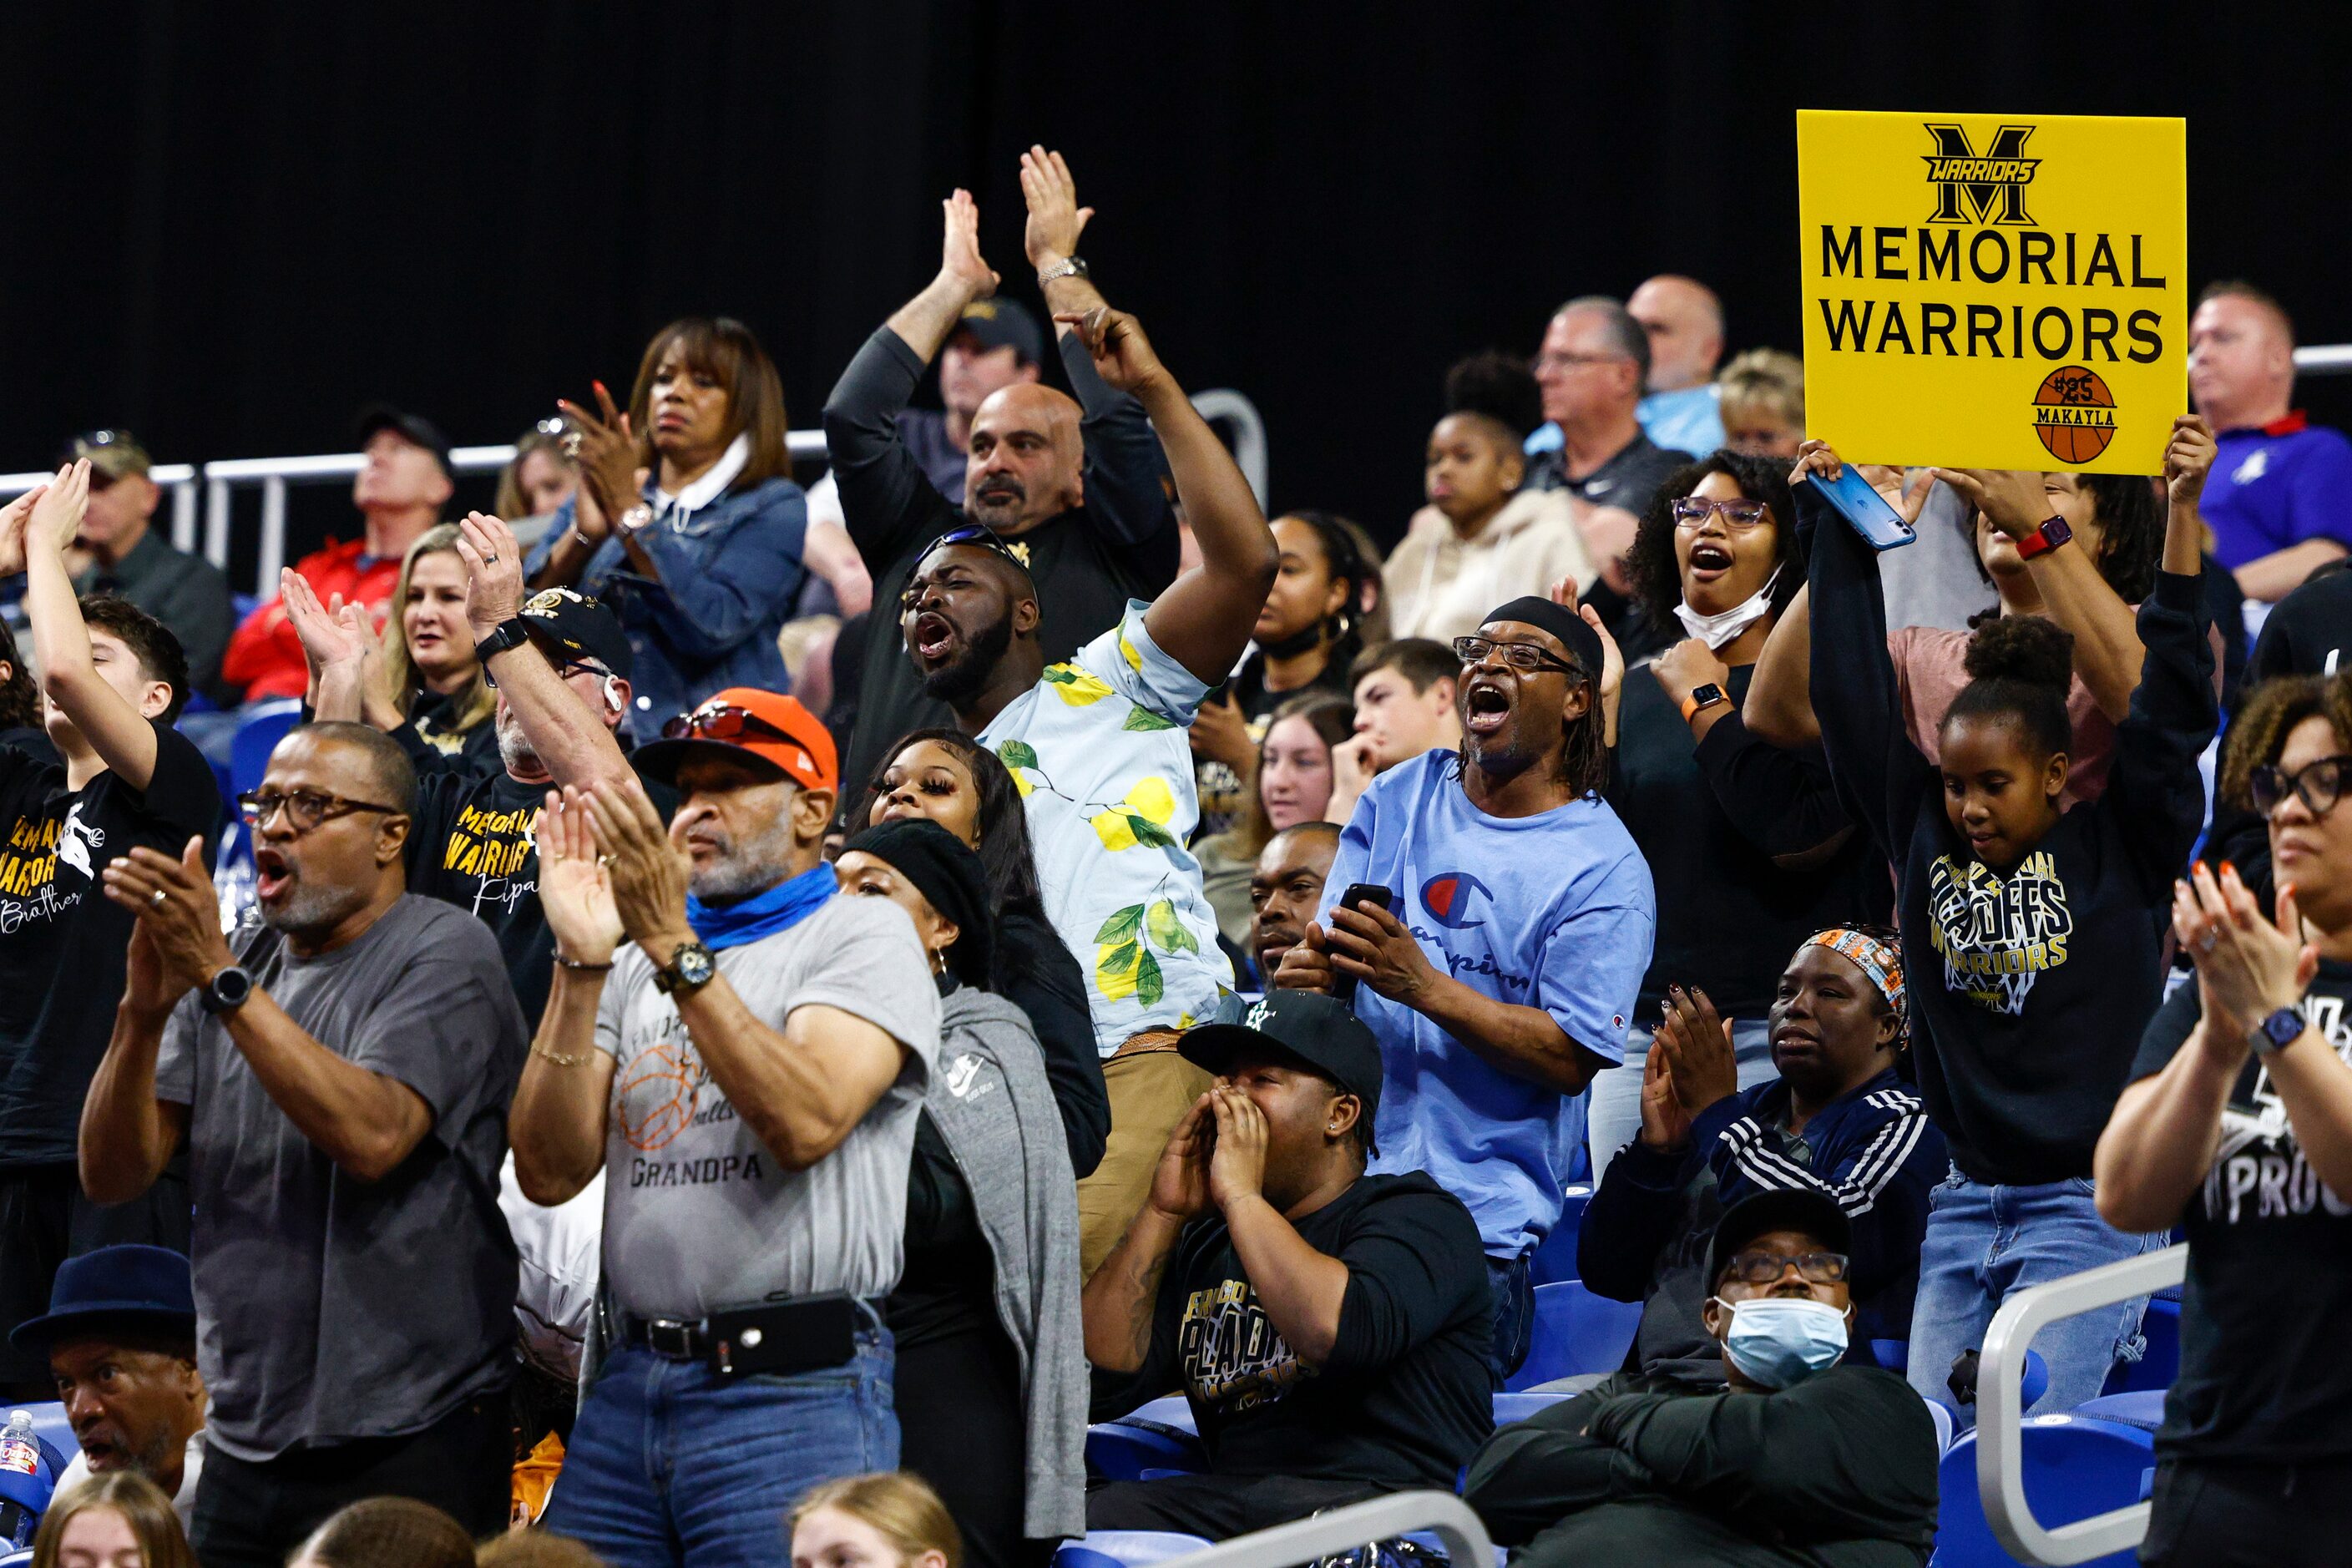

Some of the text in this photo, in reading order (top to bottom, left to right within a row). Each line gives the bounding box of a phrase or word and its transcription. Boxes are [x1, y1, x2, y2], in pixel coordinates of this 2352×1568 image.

[1930, 159, 2036, 182] WARRIORS
[1821, 225, 2167, 290] MEMORIAL
[1818, 299, 2163, 364] WARRIORS
[2054, 377, 2093, 402] #25
[2037, 408, 2114, 425] MAKAYLA
[1, 883, 82, 933] Brother
[630, 1154, 763, 1188] GRANDPA
